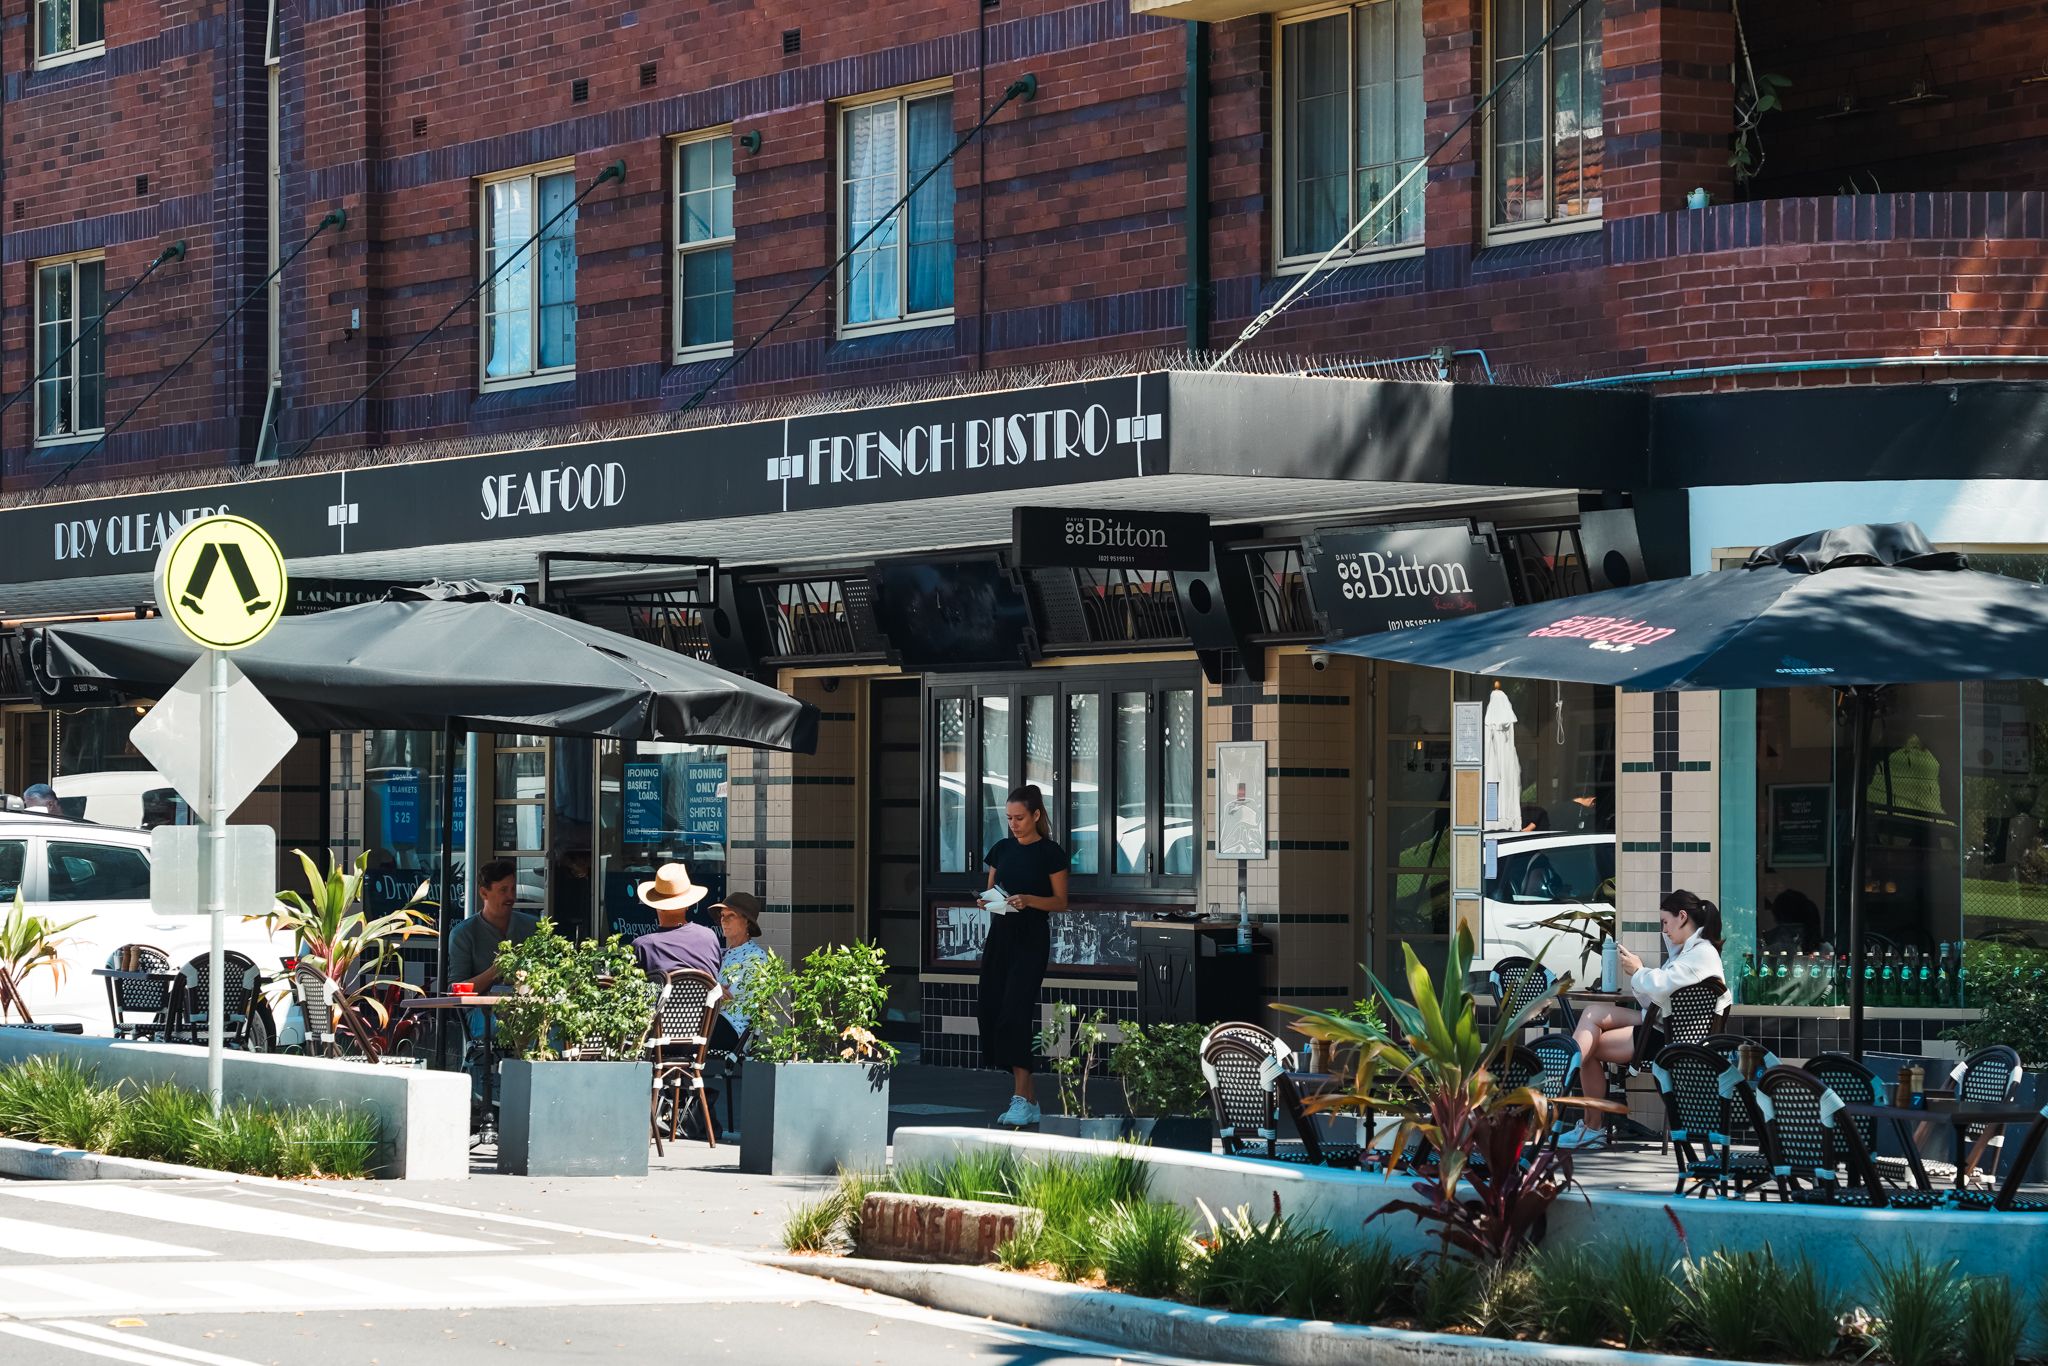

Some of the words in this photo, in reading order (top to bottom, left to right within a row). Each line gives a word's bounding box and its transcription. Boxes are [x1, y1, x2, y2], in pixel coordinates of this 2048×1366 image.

[808, 425, 955, 486] FRENCH
[966, 403, 1110, 469] BISTRO
[480, 462, 627, 522] SEAFOOD
[54, 517, 103, 562] DRY
[105, 503, 230, 556] CLEAN
[1085, 517, 1168, 548] Bitton
[1335, 553, 1357, 561] DAVID
[1358, 550, 1474, 599] Bitton
[297, 590, 385, 603] LAUNDROM
[627, 769, 659, 777] IRONING
[689, 769, 723, 780] IRONING
[391, 785, 418, 794] BLANKETS
[627, 781, 651, 790] BASKET
[696, 782, 716, 793] ONLY
[638, 791, 660, 801] LOADS.
[401, 812, 411, 823] 25
[689, 807, 716, 818] SHIRTS
[716, 807, 723, 818] &
[452, 820, 464, 832] 30
[1913, 1095, 1922, 1105] 7
